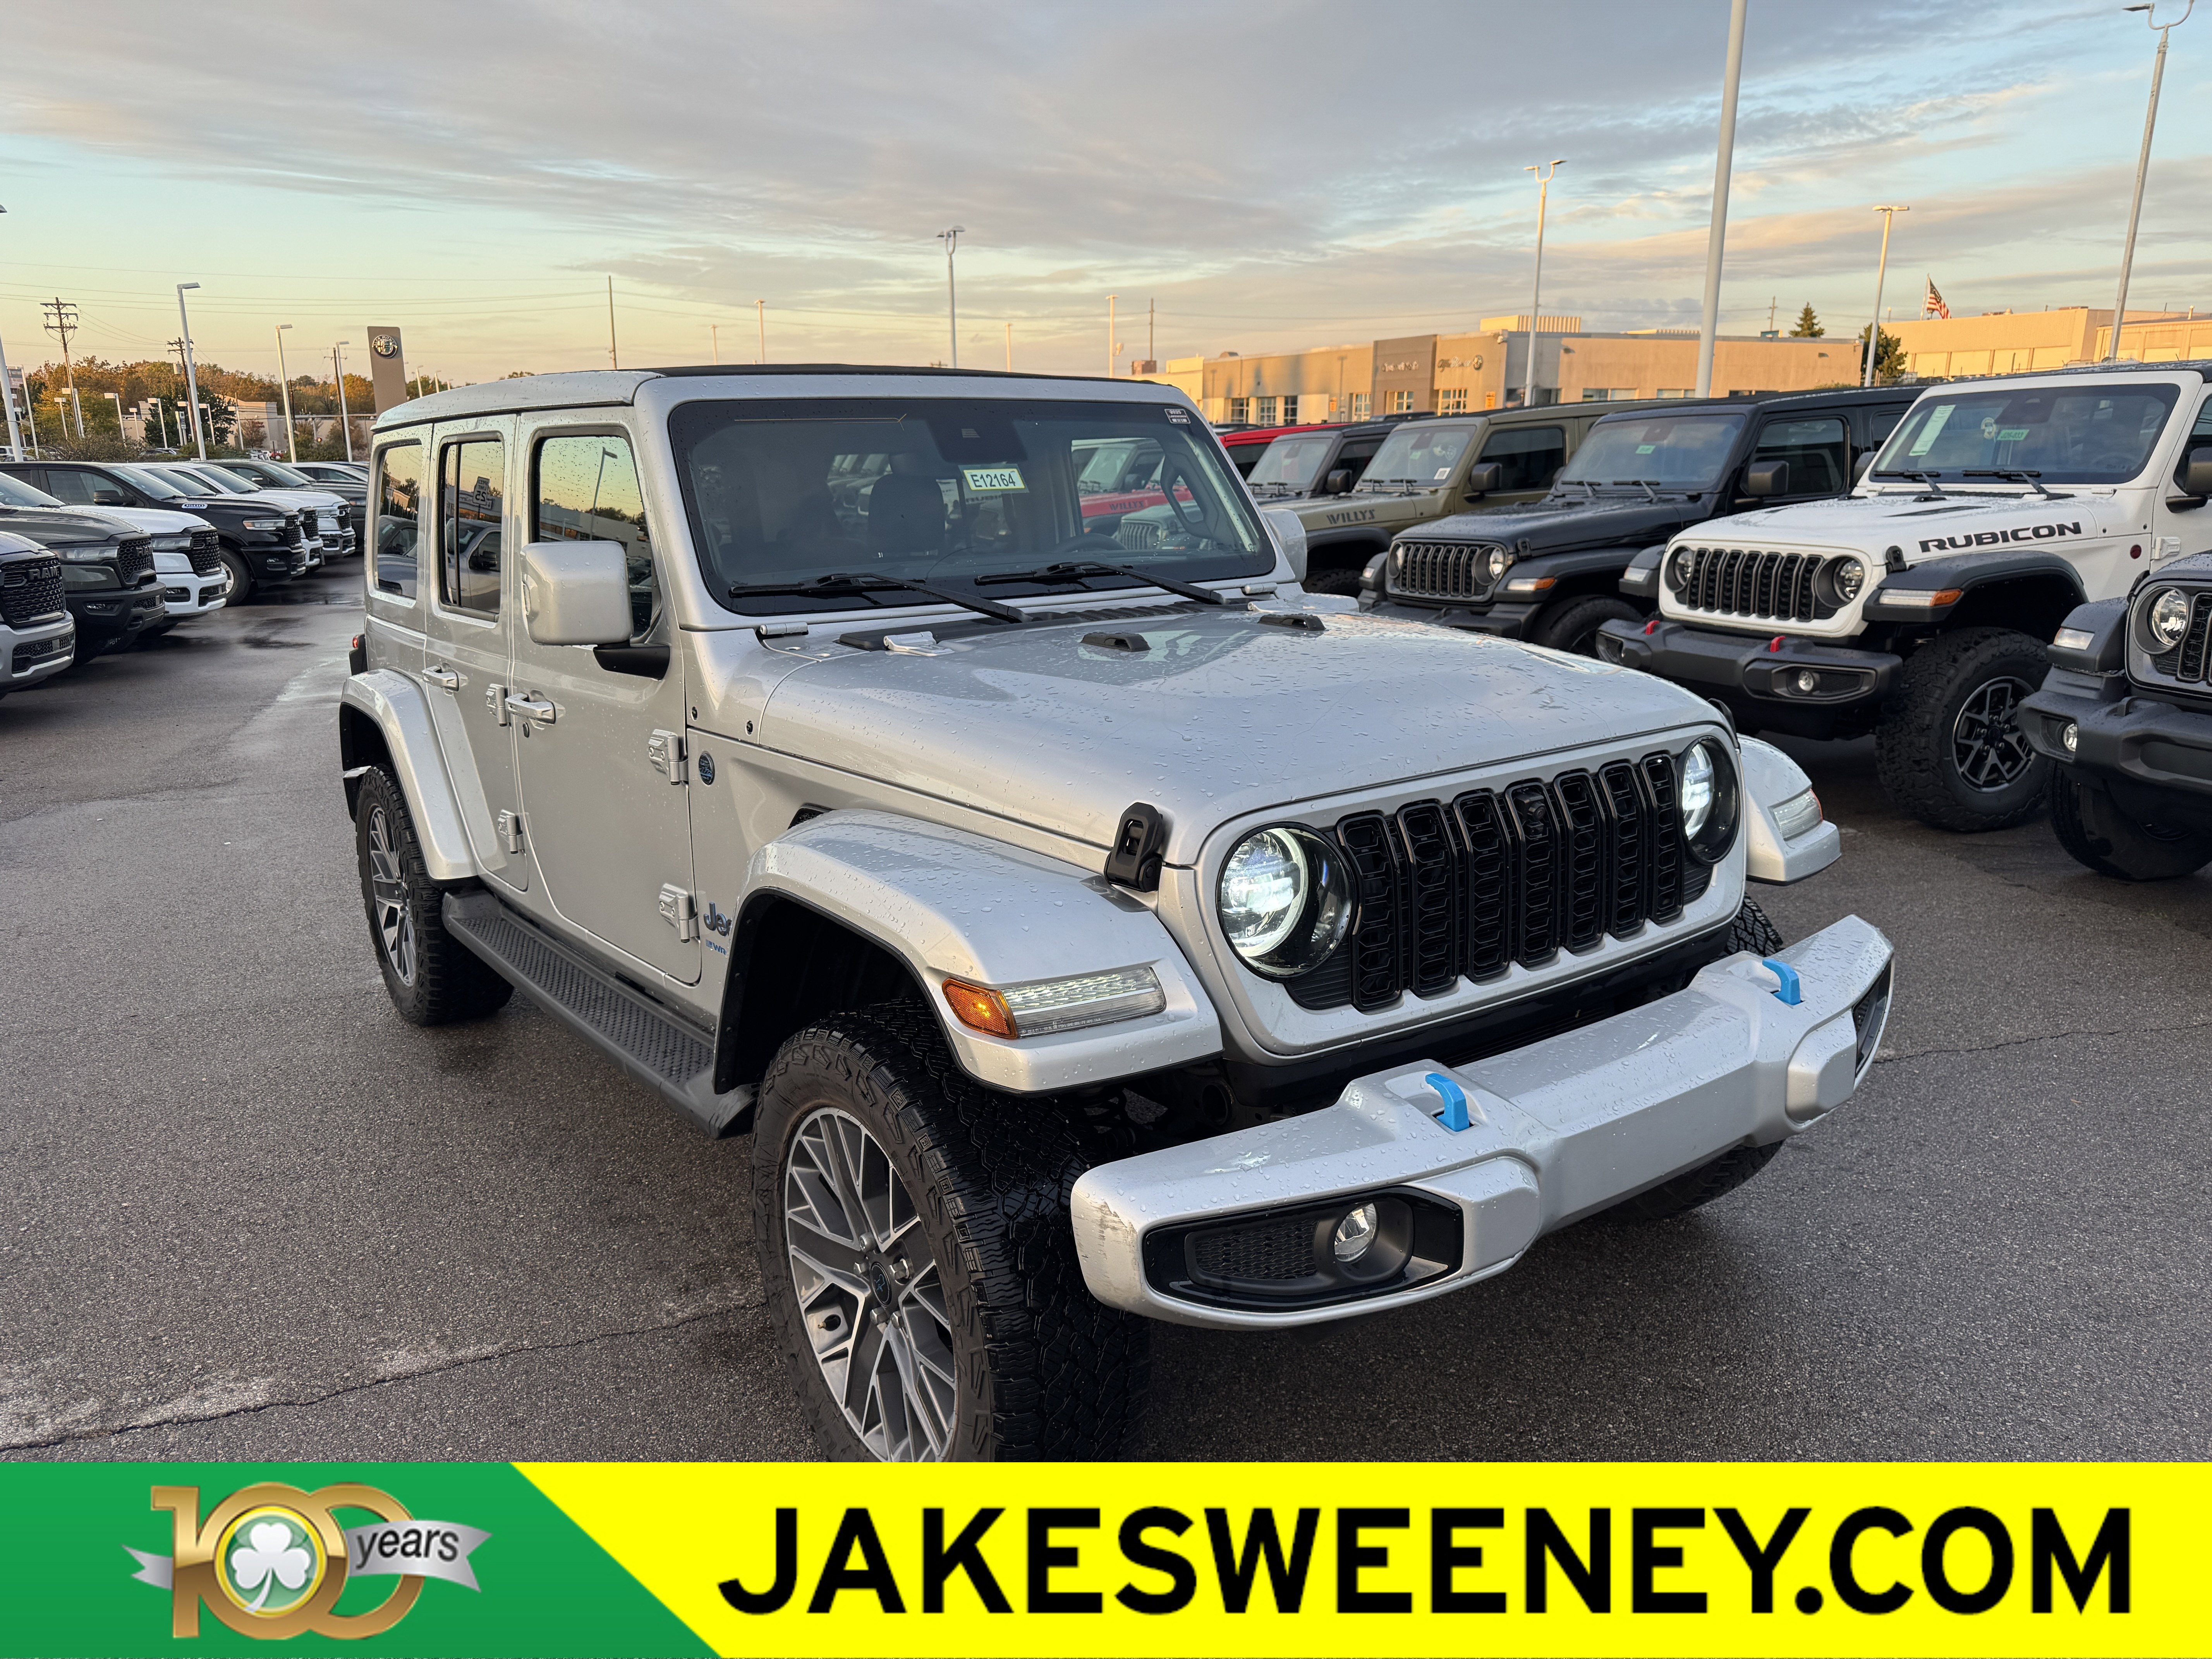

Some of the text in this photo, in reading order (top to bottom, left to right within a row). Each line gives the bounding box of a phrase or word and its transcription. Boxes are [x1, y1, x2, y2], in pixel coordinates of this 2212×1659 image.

[970, 473, 1016, 488] E12164
[1326, 509, 1375, 524] WILLYS
[1918, 522, 2081, 553] RUBICON
